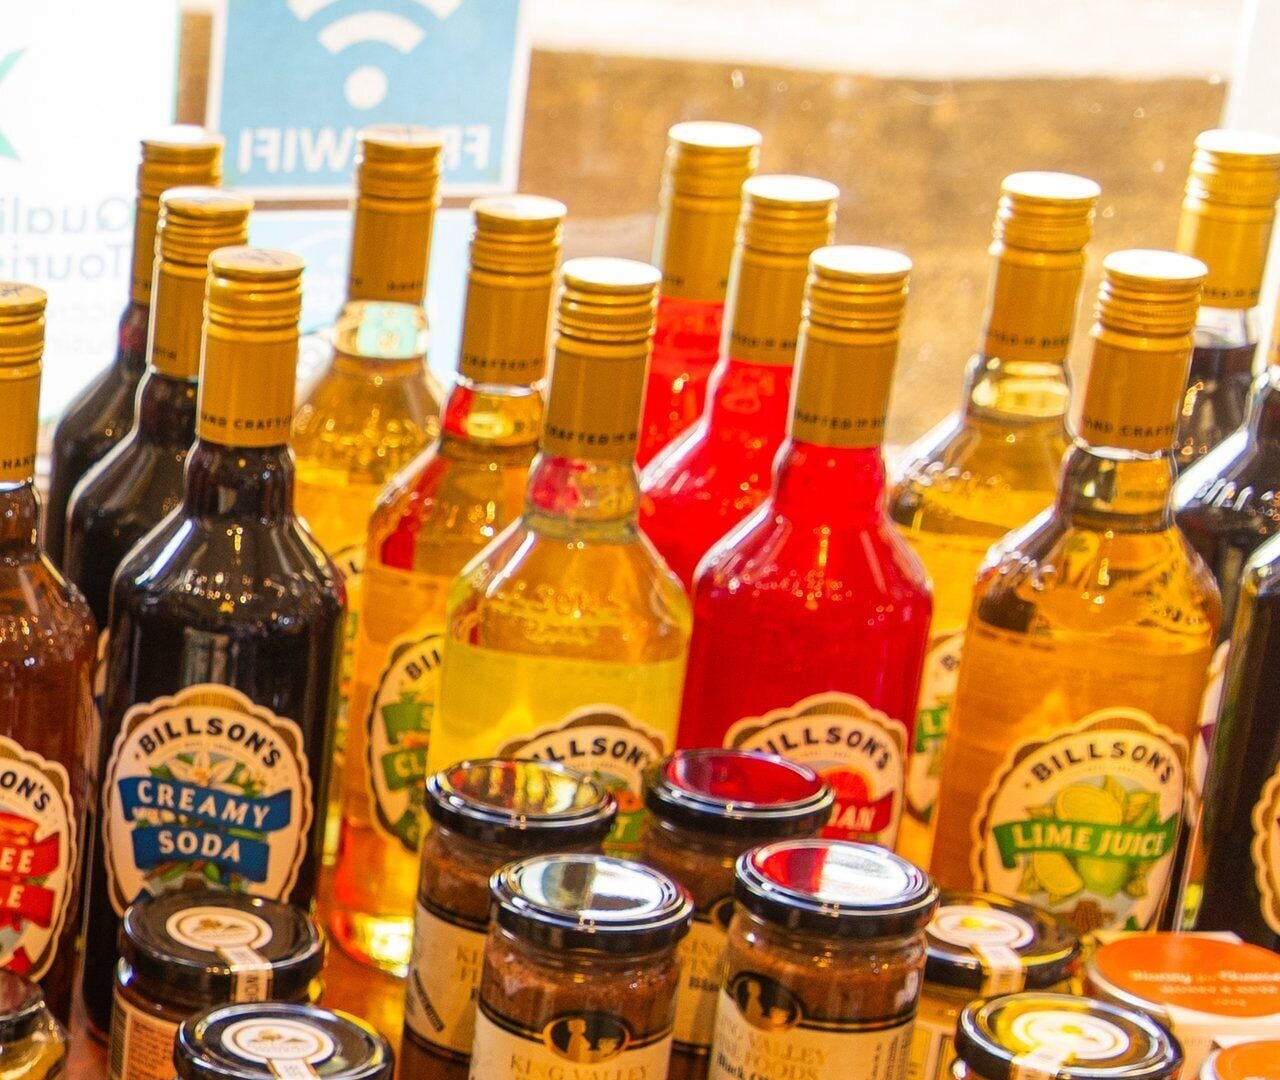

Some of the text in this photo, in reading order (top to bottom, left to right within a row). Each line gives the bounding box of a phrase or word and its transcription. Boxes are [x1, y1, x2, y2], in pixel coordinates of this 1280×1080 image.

[139, 717, 282, 769] BILLSON'S
[1030, 741, 1175, 785] BILLSON'S
[136, 779, 272, 829] CREAMY
[157, 830, 241, 864] SODA
[1012, 823, 1168, 857] LIME JUICE
